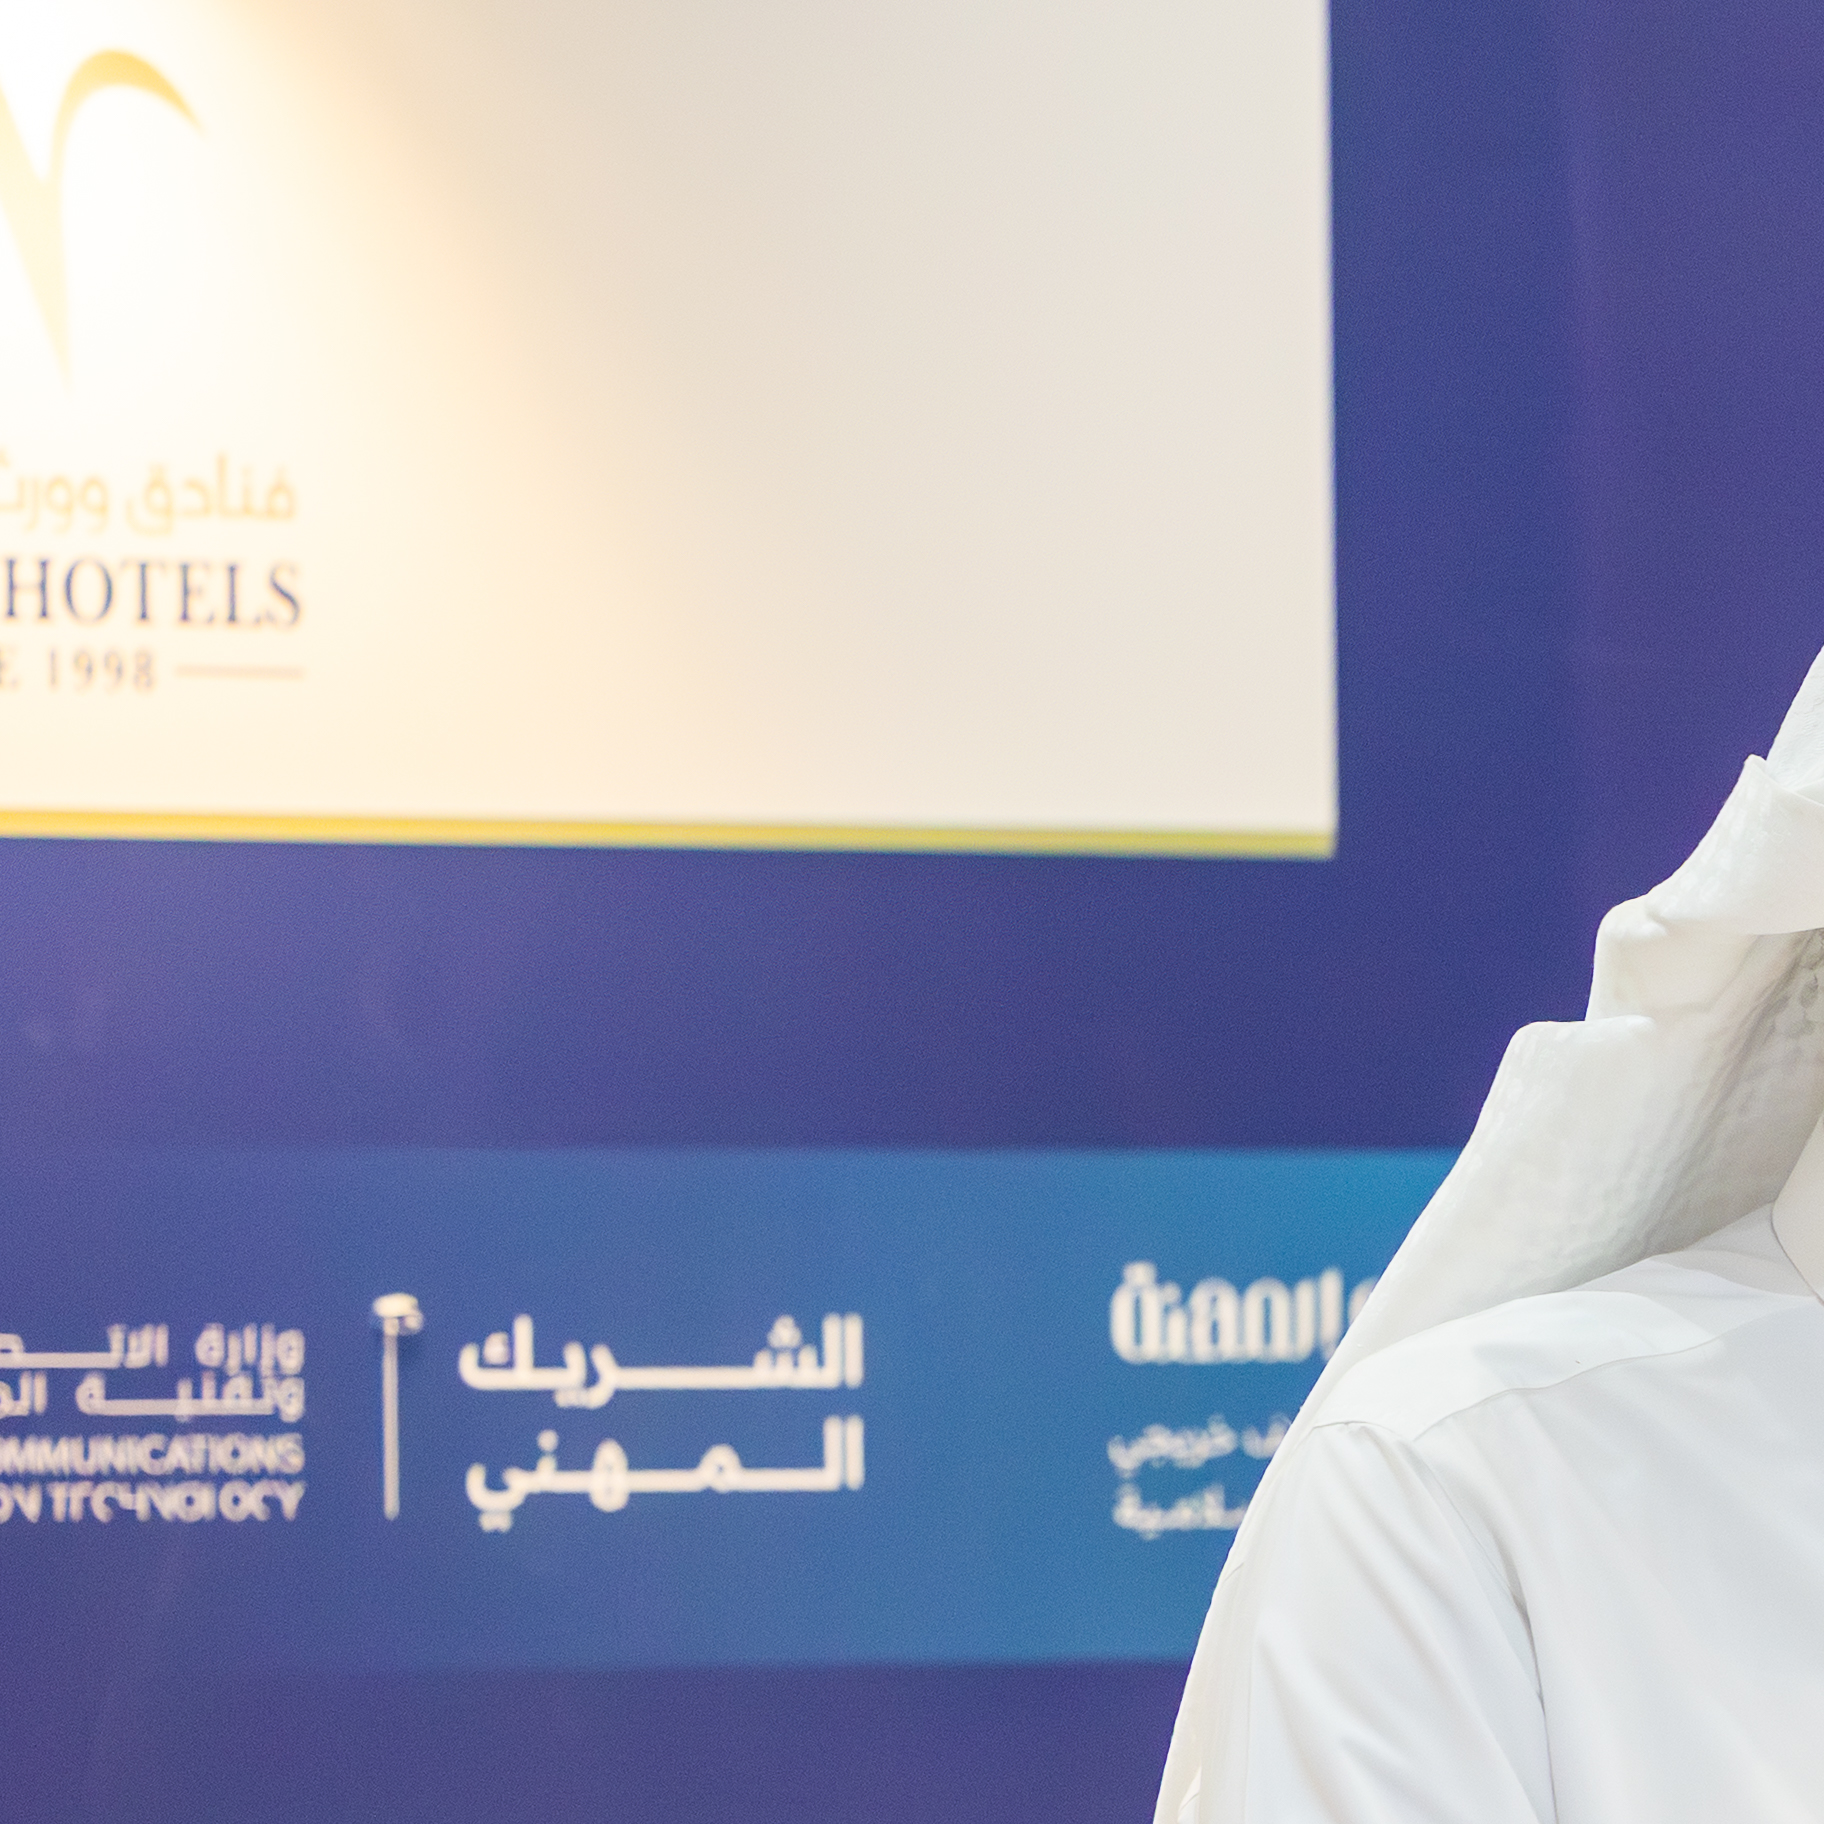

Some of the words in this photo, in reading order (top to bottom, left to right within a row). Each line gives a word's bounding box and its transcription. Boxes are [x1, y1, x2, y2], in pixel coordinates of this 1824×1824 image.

[125, 450, 298, 537] فنادق
[5, 556, 302, 629] HOTELS
[458, 1312, 864, 1408] الشريك
[0, 1432, 305, 1476] MMUNICATIONS
[465, 1414, 865, 1533] المهني
